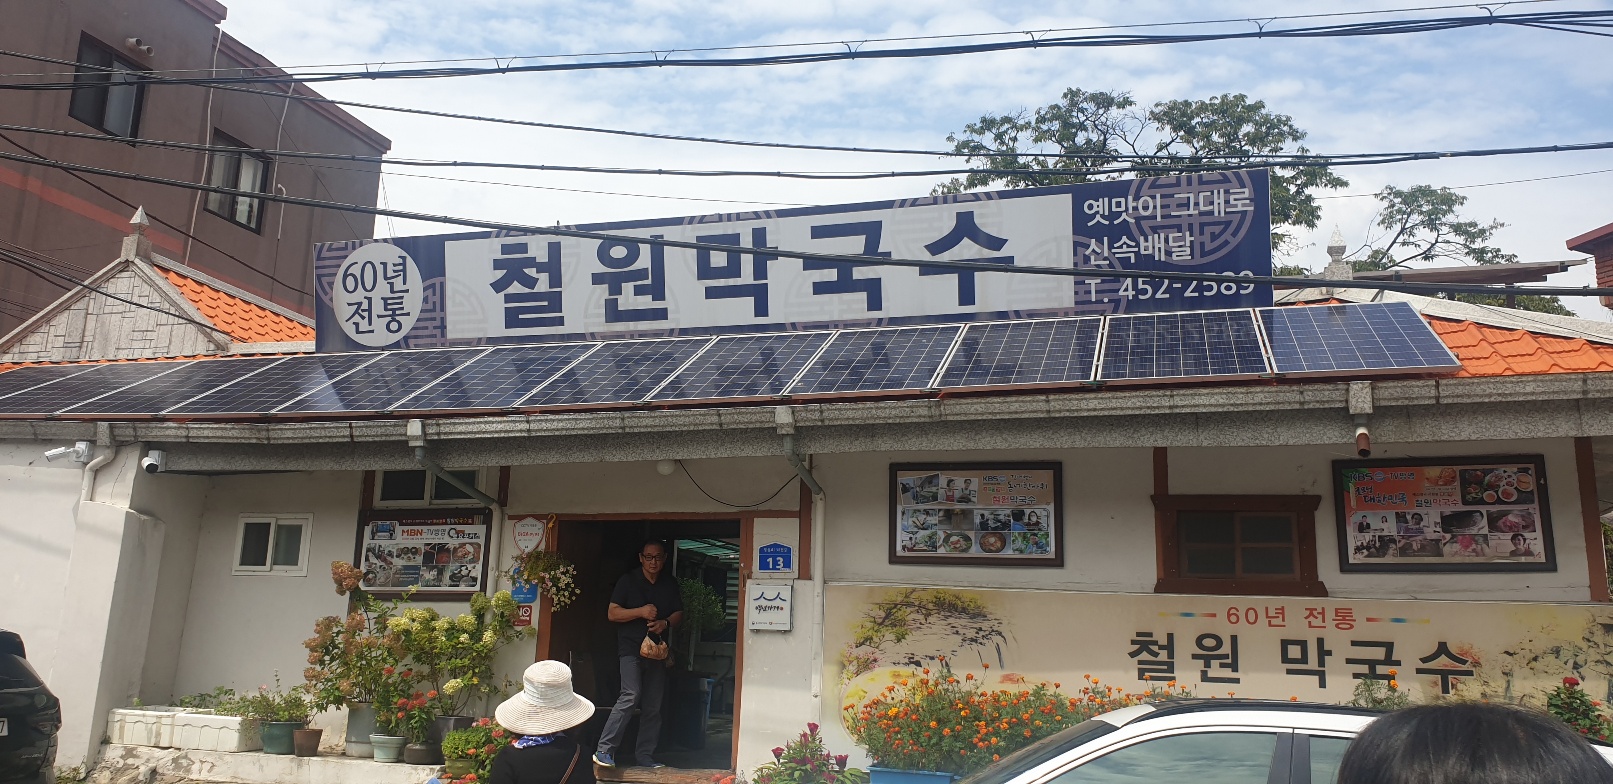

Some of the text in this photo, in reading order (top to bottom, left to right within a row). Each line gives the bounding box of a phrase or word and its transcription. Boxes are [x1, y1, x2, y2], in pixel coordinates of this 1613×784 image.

[1084, 187, 1255, 226] 옛맛이 그대로
[1084, 232, 1195, 264] 신속배달
[341, 255, 410, 294] 60년
[1119, 272, 1256, 301] 452-2589
[344, 295, 411, 335] 전통
[1350, 472, 1373, 481] KBS
[766, 556, 784, 569] 13
[1226, 606, 1357, 631] 60년 전통
[1127, 631, 1475, 695] 철원 막국수
